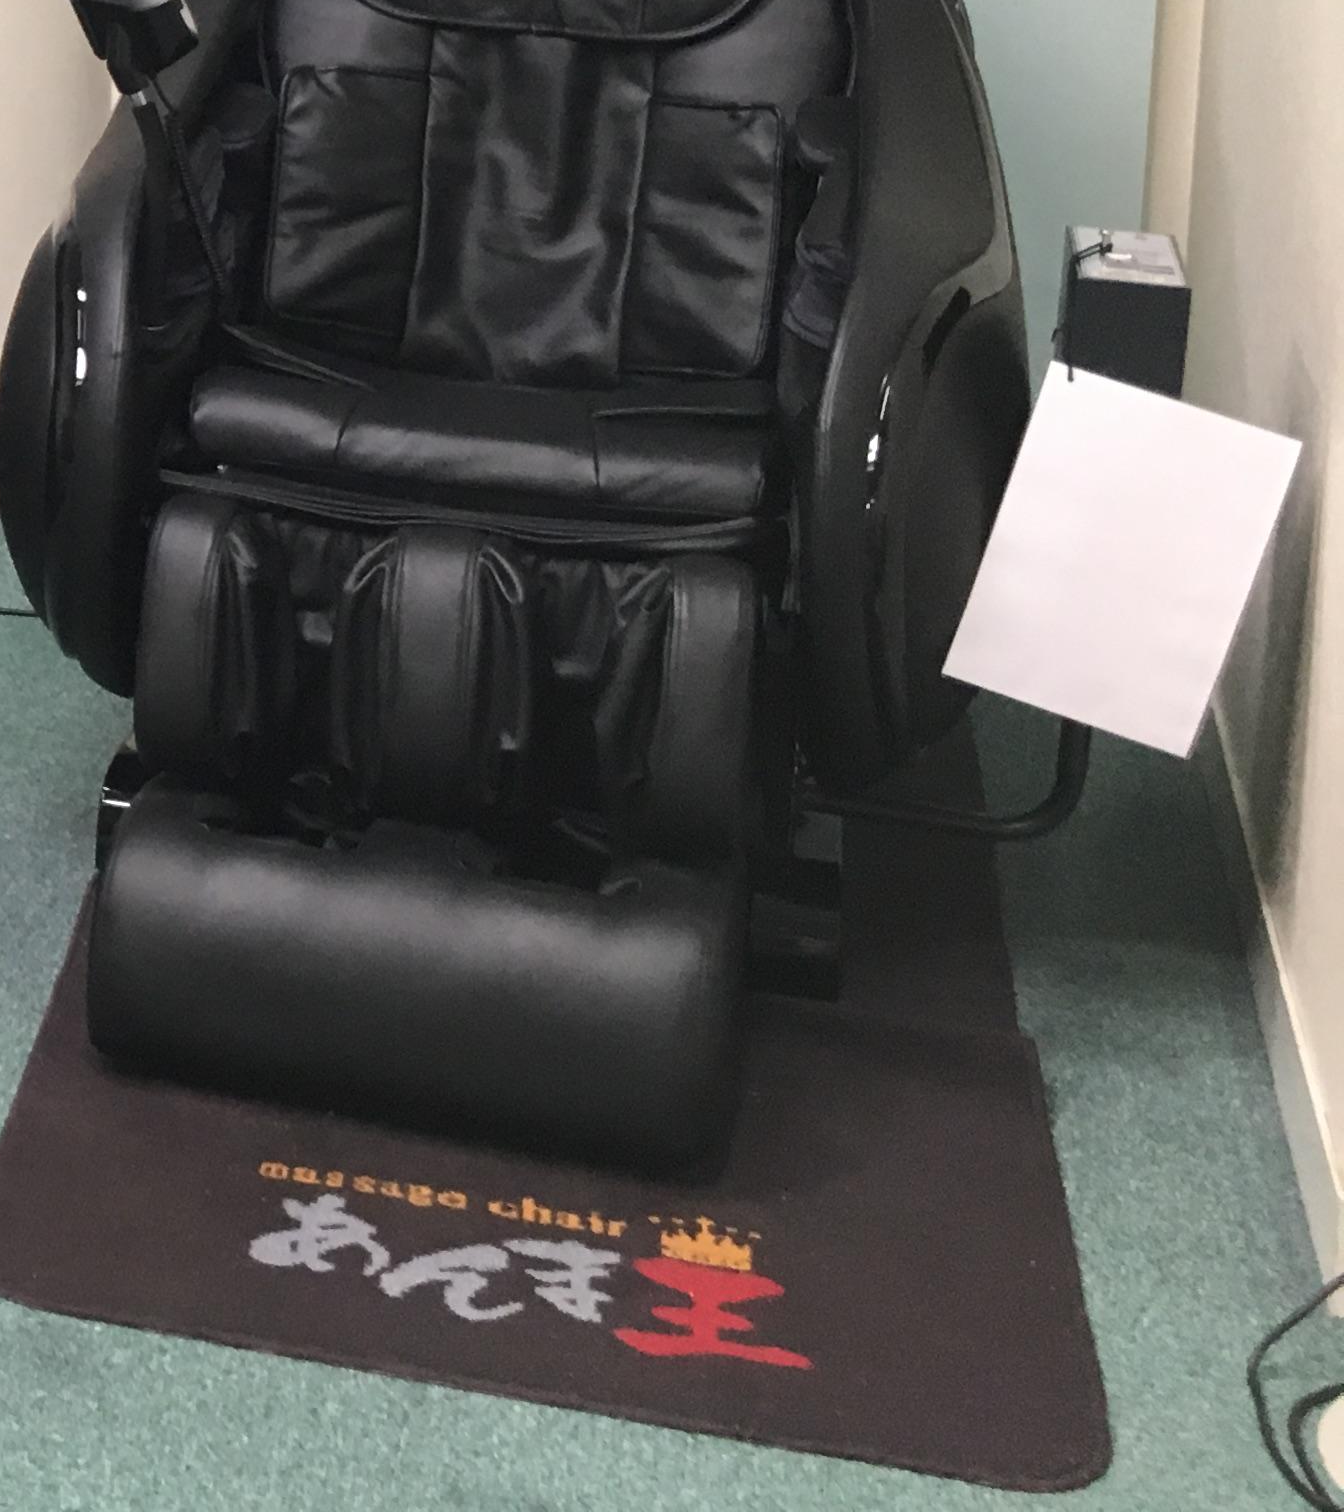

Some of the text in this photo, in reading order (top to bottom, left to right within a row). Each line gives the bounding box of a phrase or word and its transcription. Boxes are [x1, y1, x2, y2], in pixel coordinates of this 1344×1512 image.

[487, 1195, 629, 1238] chair
[249, 1192, 814, 1370] あんま王
